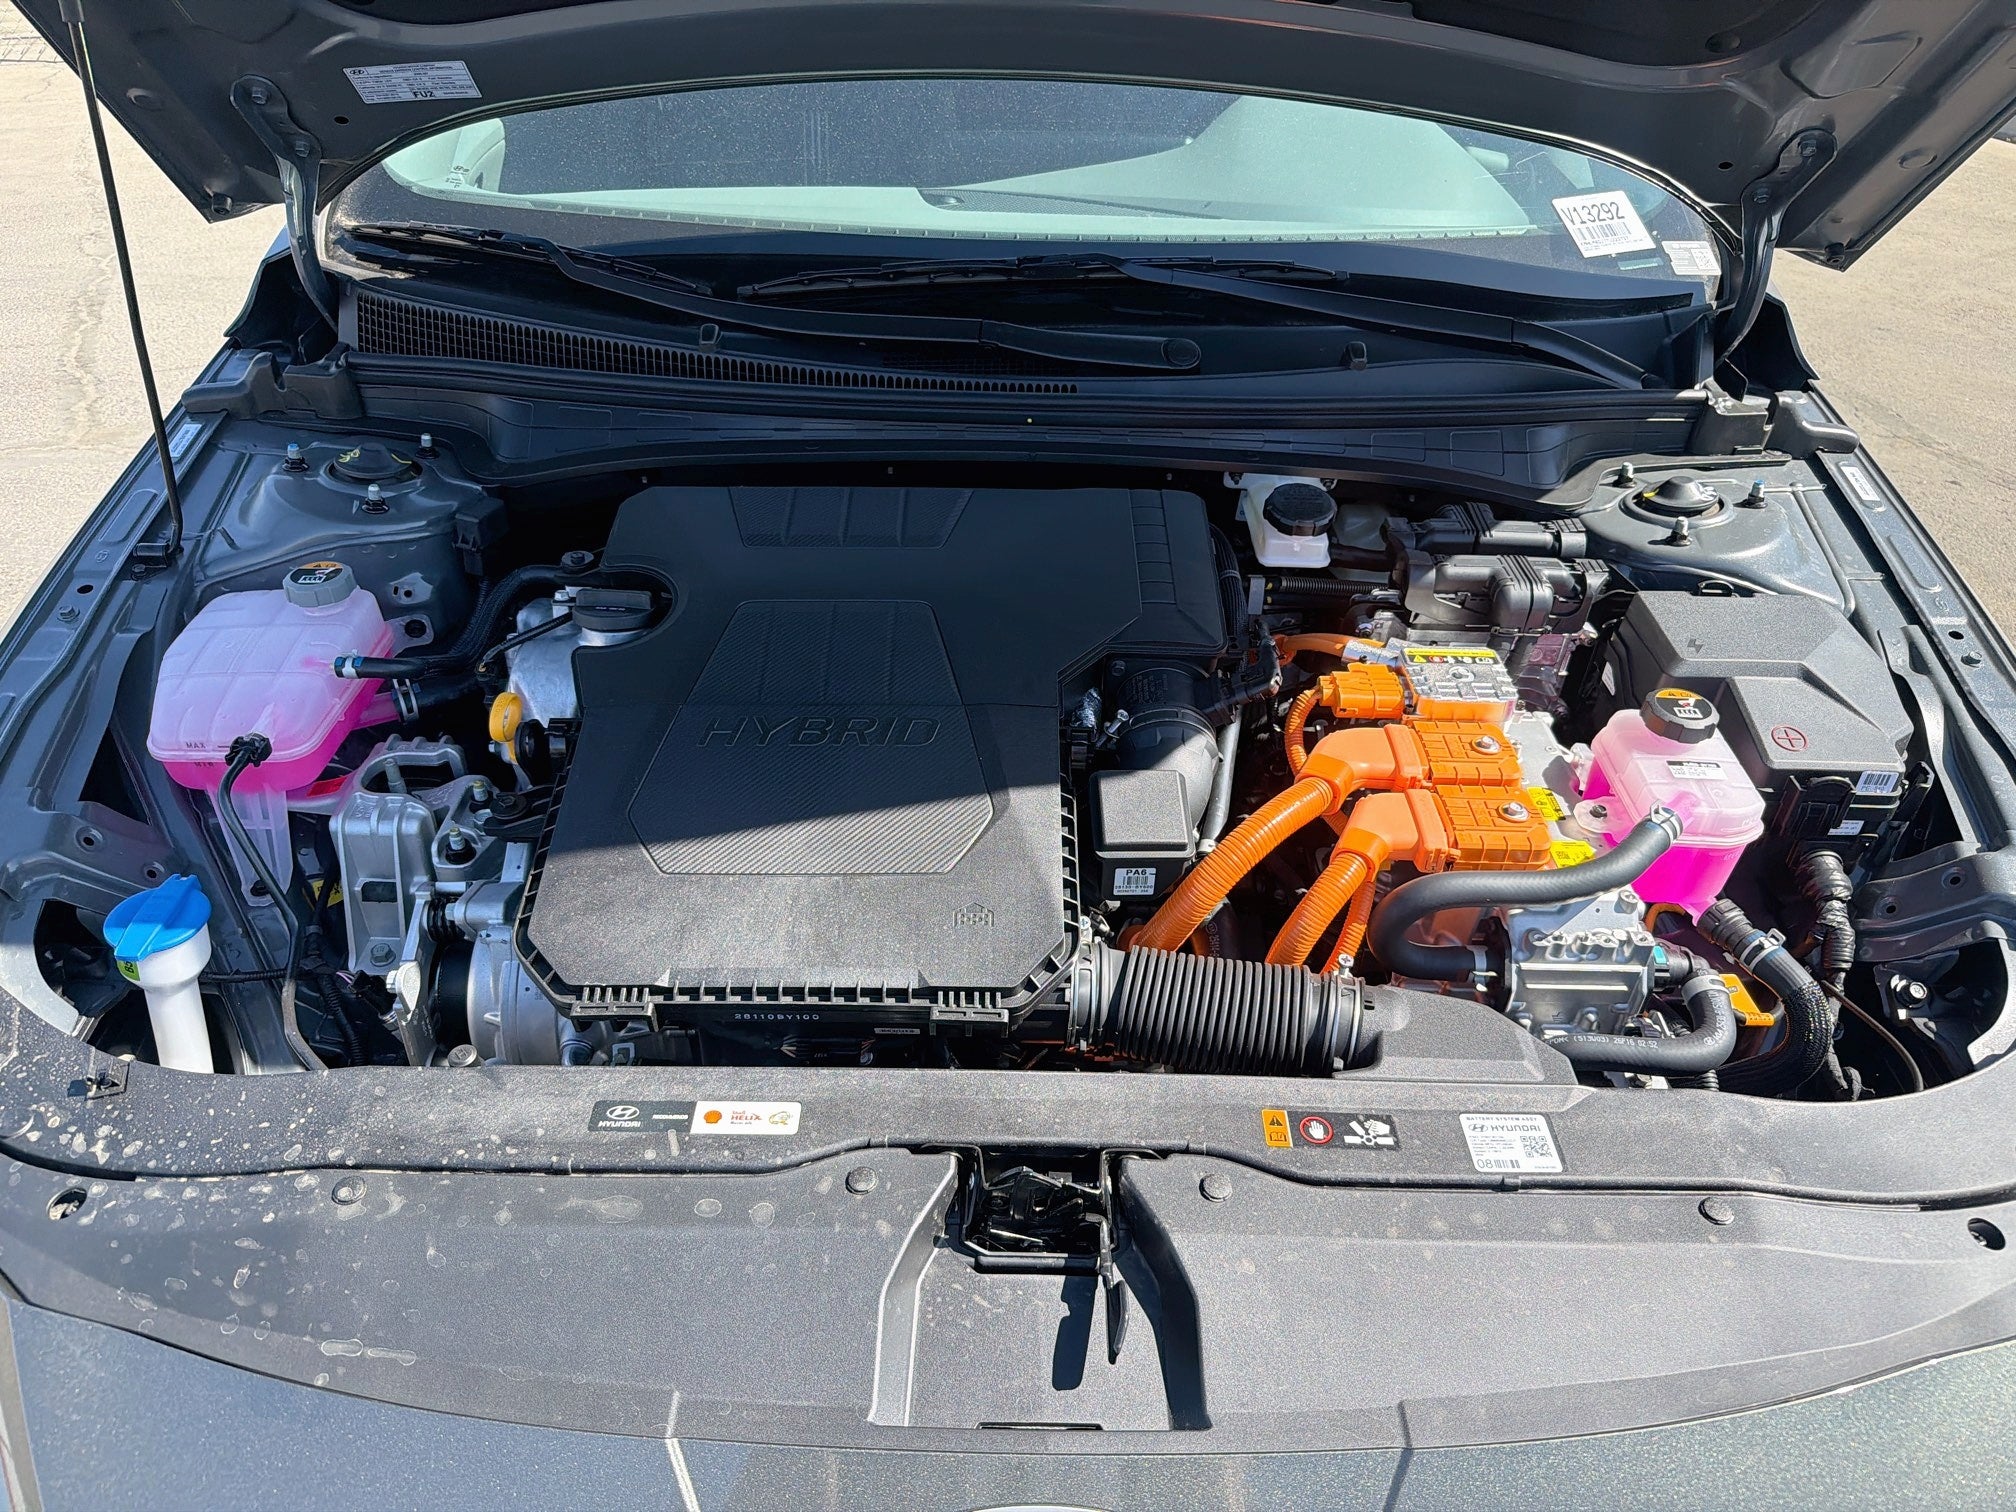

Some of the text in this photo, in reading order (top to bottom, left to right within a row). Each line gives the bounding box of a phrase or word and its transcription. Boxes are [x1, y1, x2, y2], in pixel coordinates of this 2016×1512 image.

[1560, 201, 1626, 226] V13292
[696, 715, 942, 748] HYBRID
[185, 741, 207, 749] MAX
[1126, 868, 1148, 876] PA6
[597, 1120, 642, 1128] HYUNDAI
[1490, 1124, 1541, 1132] HYUNDAI
[1476, 1158, 1493, 1169] 08
